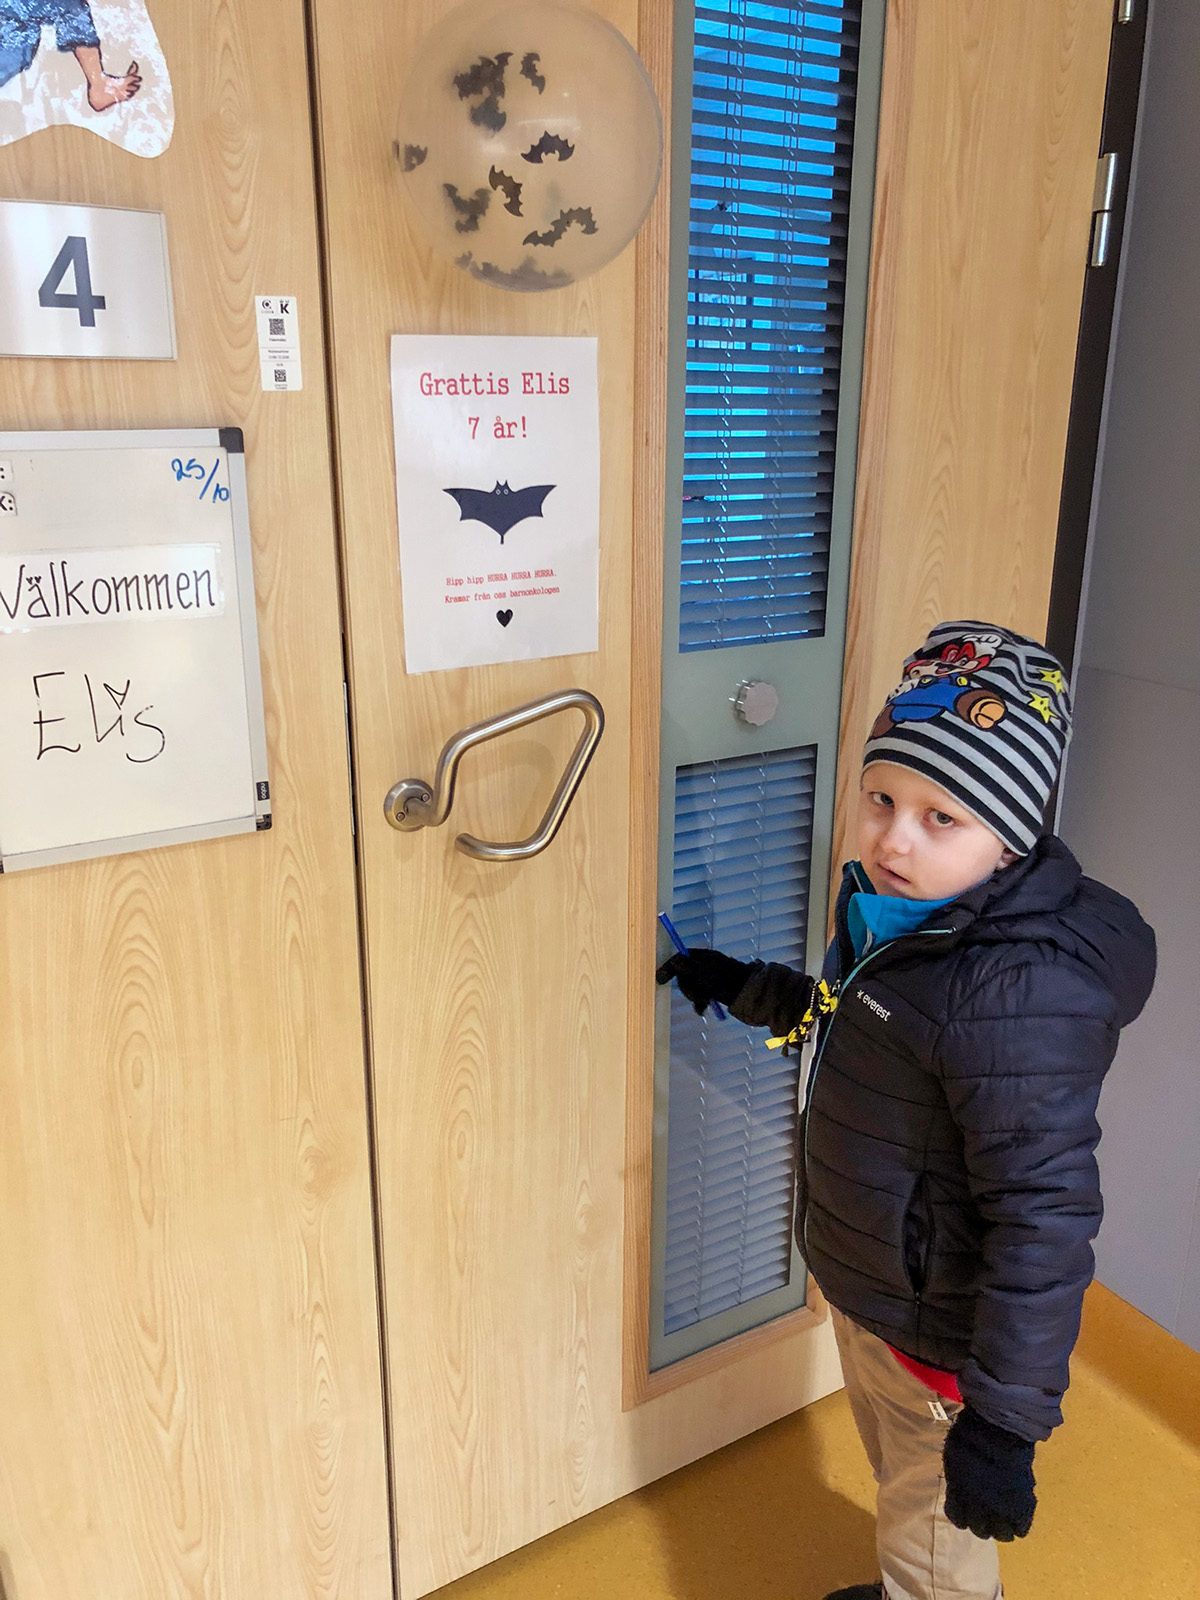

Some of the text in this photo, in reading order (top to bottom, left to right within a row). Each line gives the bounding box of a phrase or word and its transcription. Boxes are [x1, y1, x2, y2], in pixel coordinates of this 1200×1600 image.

[38, 236, 106, 327] 4
[420, 372, 570, 396] Grattis Elis
[468, 416, 527, 440] 7 år!
[172, 458, 230, 503] 25/10
[0, 561, 215, 618] Välkommen
[446, 569, 557, 586] Hipp hipp HURRA HURRA HURRA.
[445, 595, 470, 604] Kramar
[474, 592, 491, 601] från
[510, 586, 560, 598] barnonkologen
[33, 671, 165, 763] Elis
[862, 994, 891, 1022] everest
